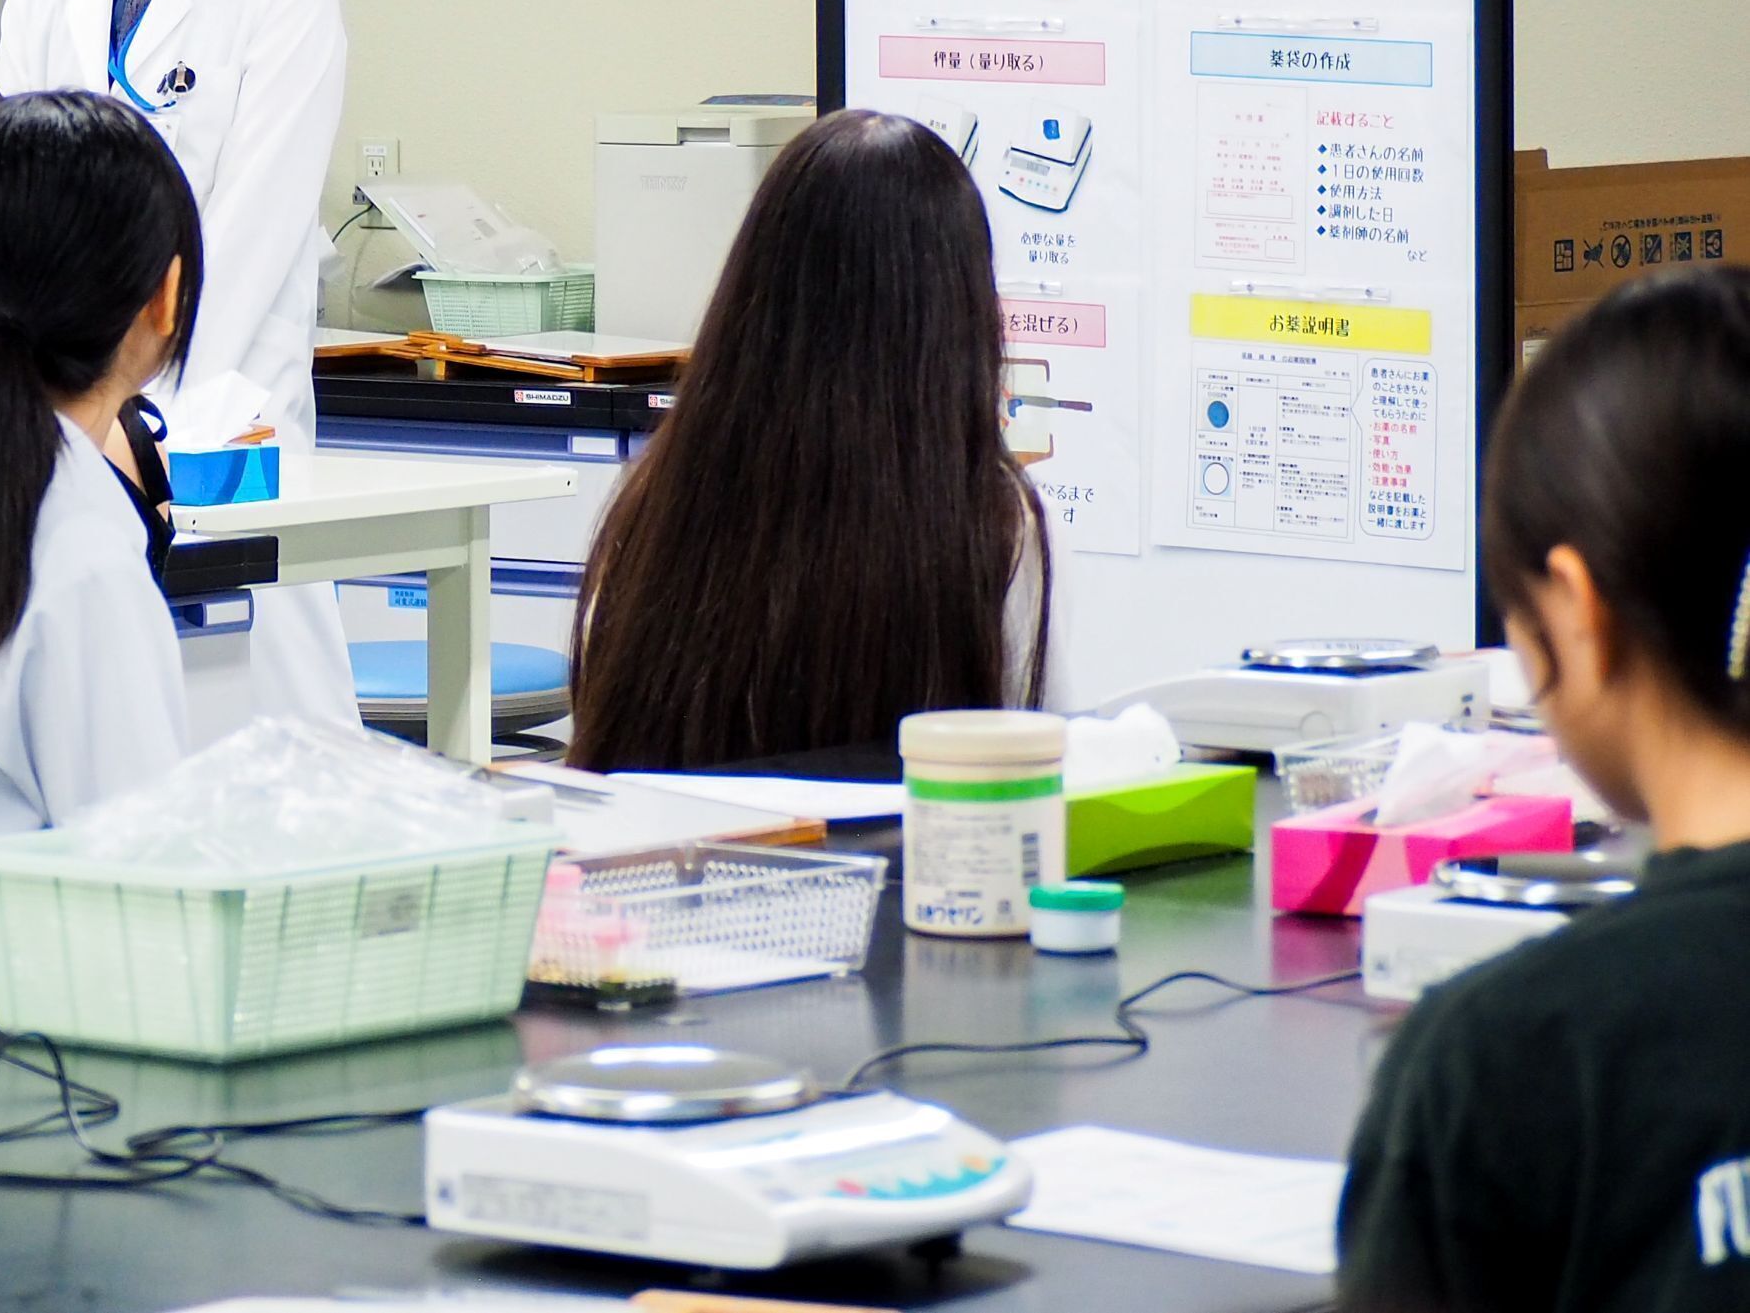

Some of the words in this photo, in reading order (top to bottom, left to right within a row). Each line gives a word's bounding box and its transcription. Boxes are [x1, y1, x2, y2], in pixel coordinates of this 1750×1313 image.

[1270, 49, 1351, 71] 薬袋の作成
[1316, 111, 1395, 129] 記載すること
[1330, 143, 1424, 162] 患者さんの名前
[1330, 184, 1382, 200] 使用方法
[1328, 204, 1394, 222] 調剤した日
[1020, 231, 1076, 248] 必要な量を
[1328, 224, 1409, 244] 薬剤師の名前
[1028, 251, 1069, 264] 量り取る
[1407, 250, 1428, 262] など
[1269, 314, 1350, 337] お薬説明書
[525, 393, 569, 402] SHIMADZU
